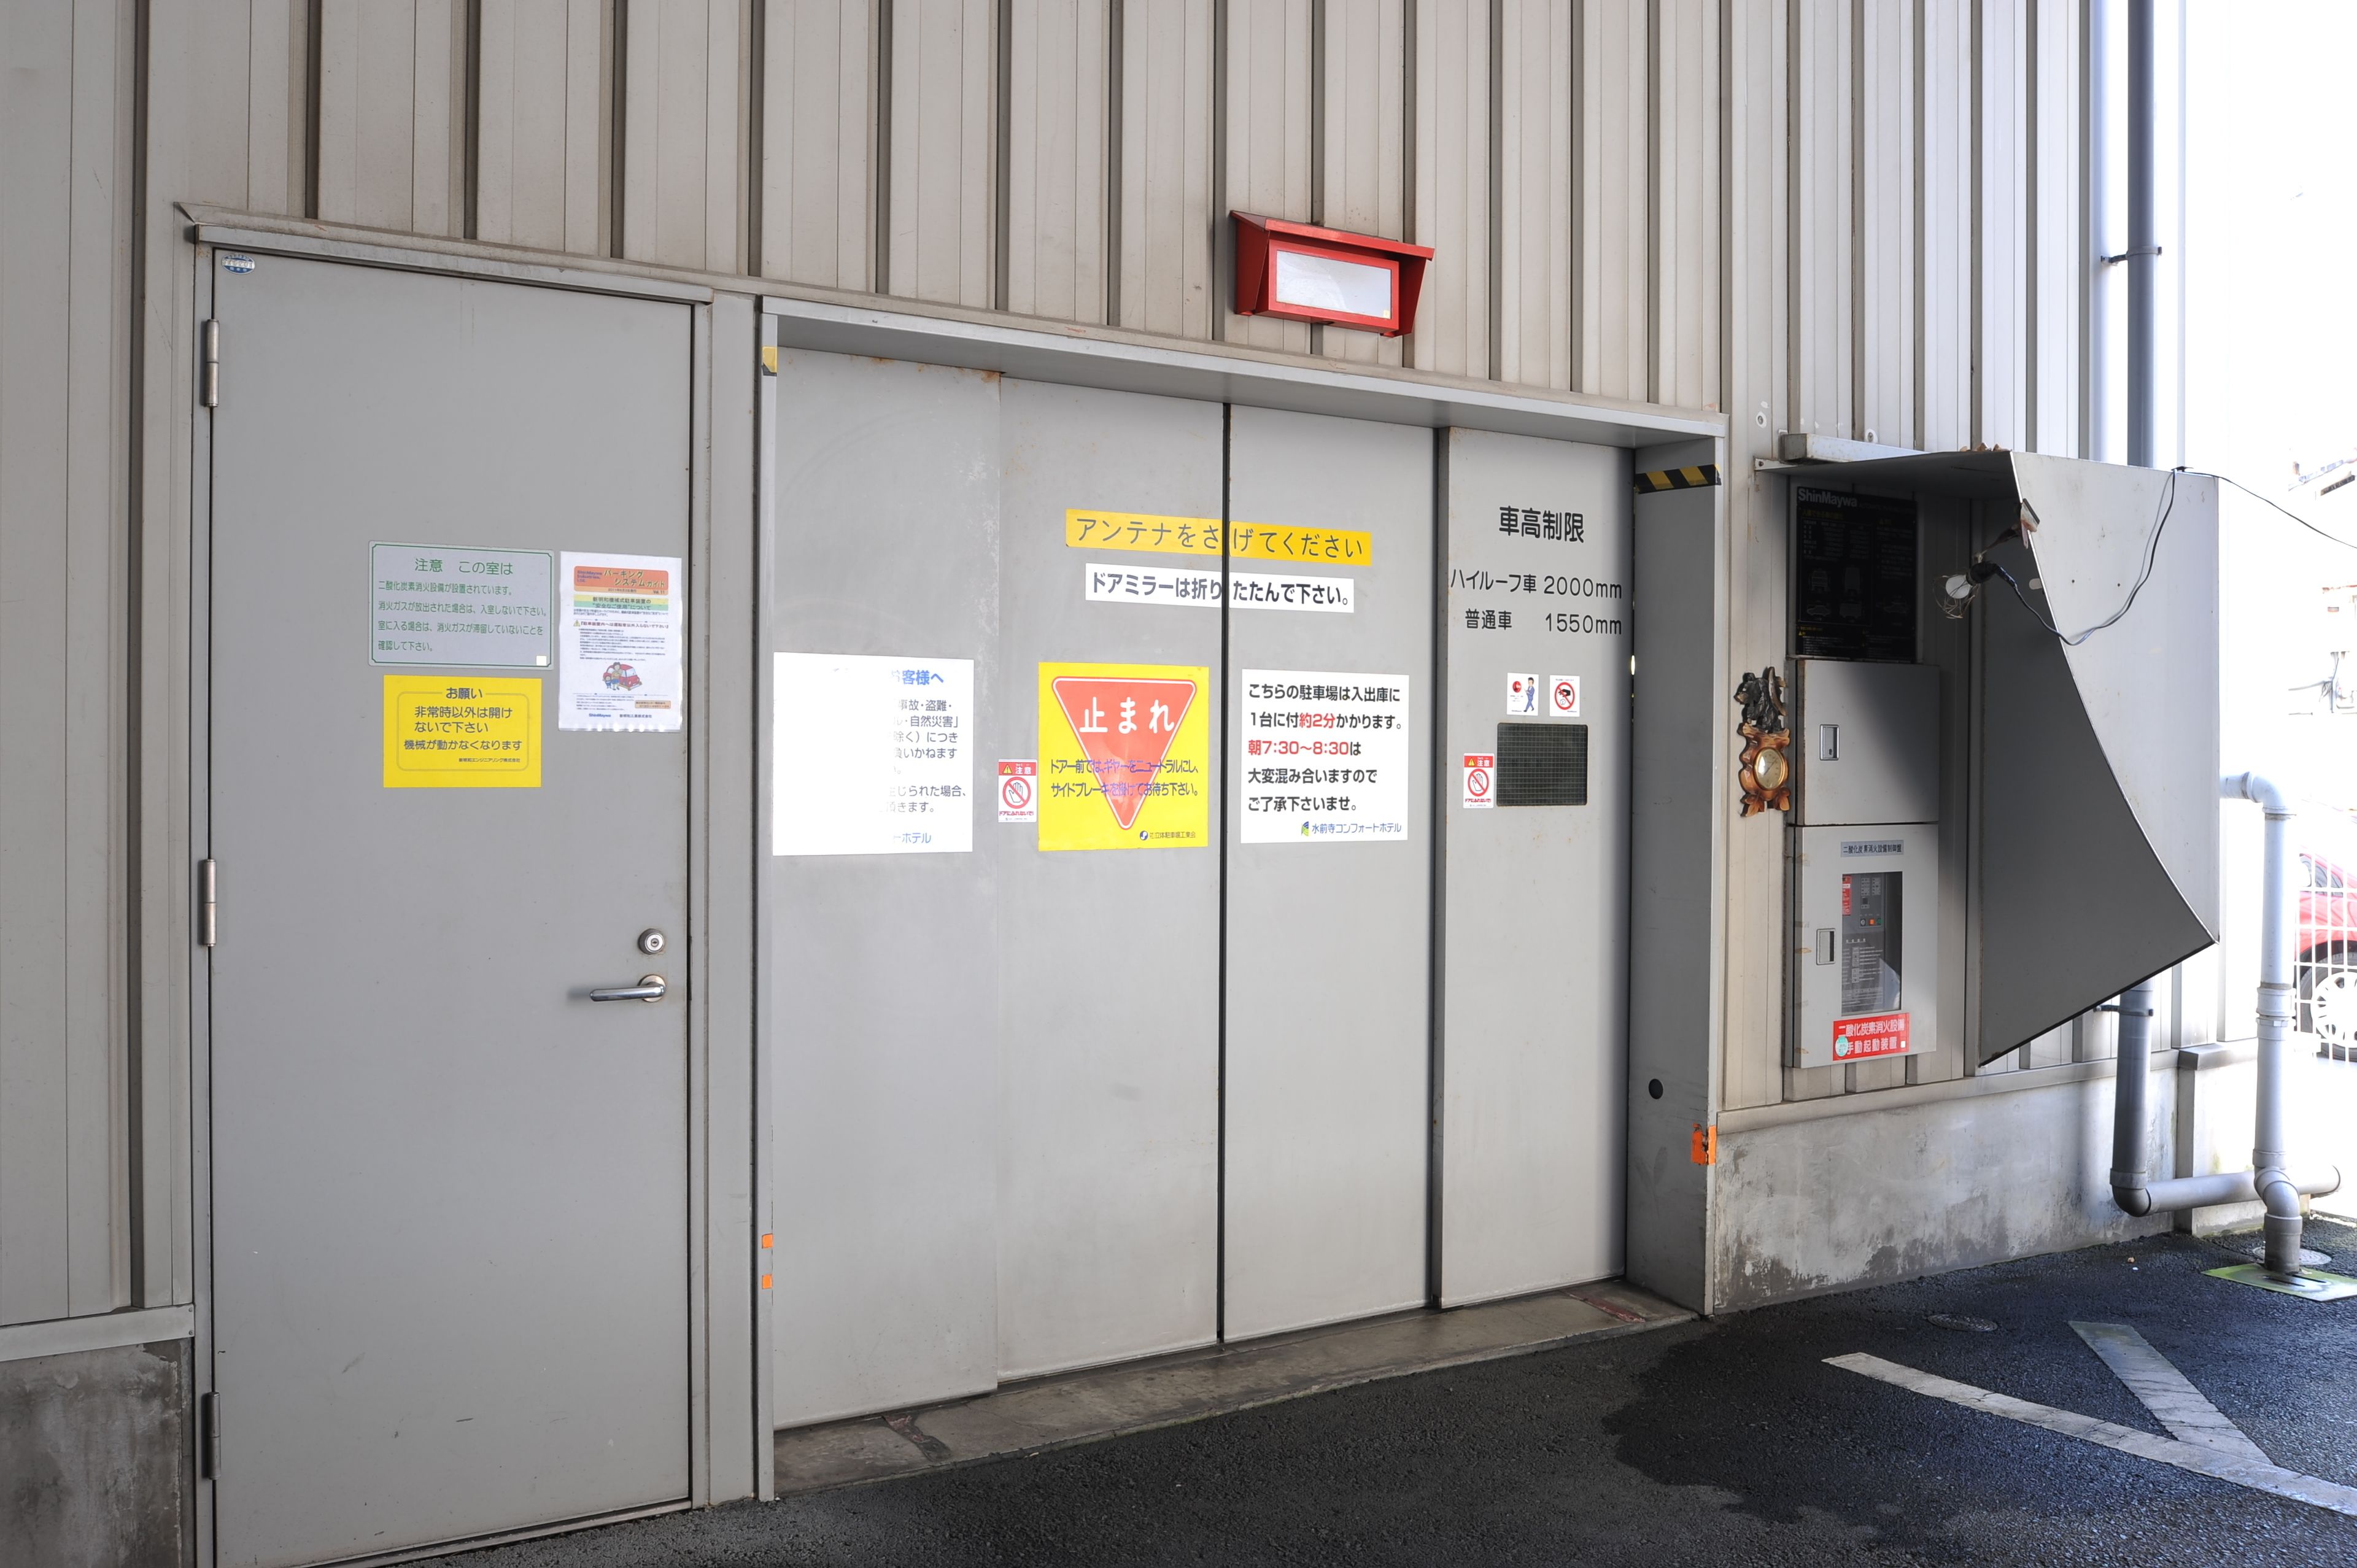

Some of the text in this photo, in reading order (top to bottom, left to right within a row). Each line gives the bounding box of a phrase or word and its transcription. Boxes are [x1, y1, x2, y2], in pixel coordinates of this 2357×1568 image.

[1798, 488, 1857, 508] ShinMaywa
[1499, 505, 1585, 543] 車高制限
[1077, 518, 1363, 558] アンテナをさげてください
[414, 558, 514, 576] 注意 この室は
[604, 570, 643, 579] パーキング
[378, 581, 512, 596] 二酸化炭素消火設備が設置されています。
[1093, 572, 1349, 606] ドアミラーは折りたたんで下さい。
[1450, 568, 1622, 599] ハイルーフ車 2000mm
[378, 601, 547, 617] 消火ガスが放出された場合は、入室しないで下さい。
[377, 620, 544, 636] 室に入る場合は、消火ガスが滞留していないことを
[1465, 608, 1622, 635] 普通車 1550mm
[378, 640, 433, 652] 確認して下さい。
[446, 687, 484, 700] お願い
[1249, 684, 1401, 703] こちらの駐車場は入出庫に
[414, 706, 513, 719] 非常時以外は開け
[1079, 696, 1175, 734] 止まれ
[414, 721, 489, 734] ないで下さい
[1250, 712, 1401, 730] 1台に付約2分かかります。
[404, 740, 523, 751] 機械が動かなくなります
[1248, 768, 1377, 784] 大変混み合いますので
[1051, 782, 1198, 798] サイドブレーキを掛けてお待ち下さい。
[1248, 796, 1357, 813] ご了承下さいませ。
[1312, 823, 1402, 835] 水前寺コンフォートホテル
[1838, 1019, 1905, 1037] 二酸化炭素消火設備
